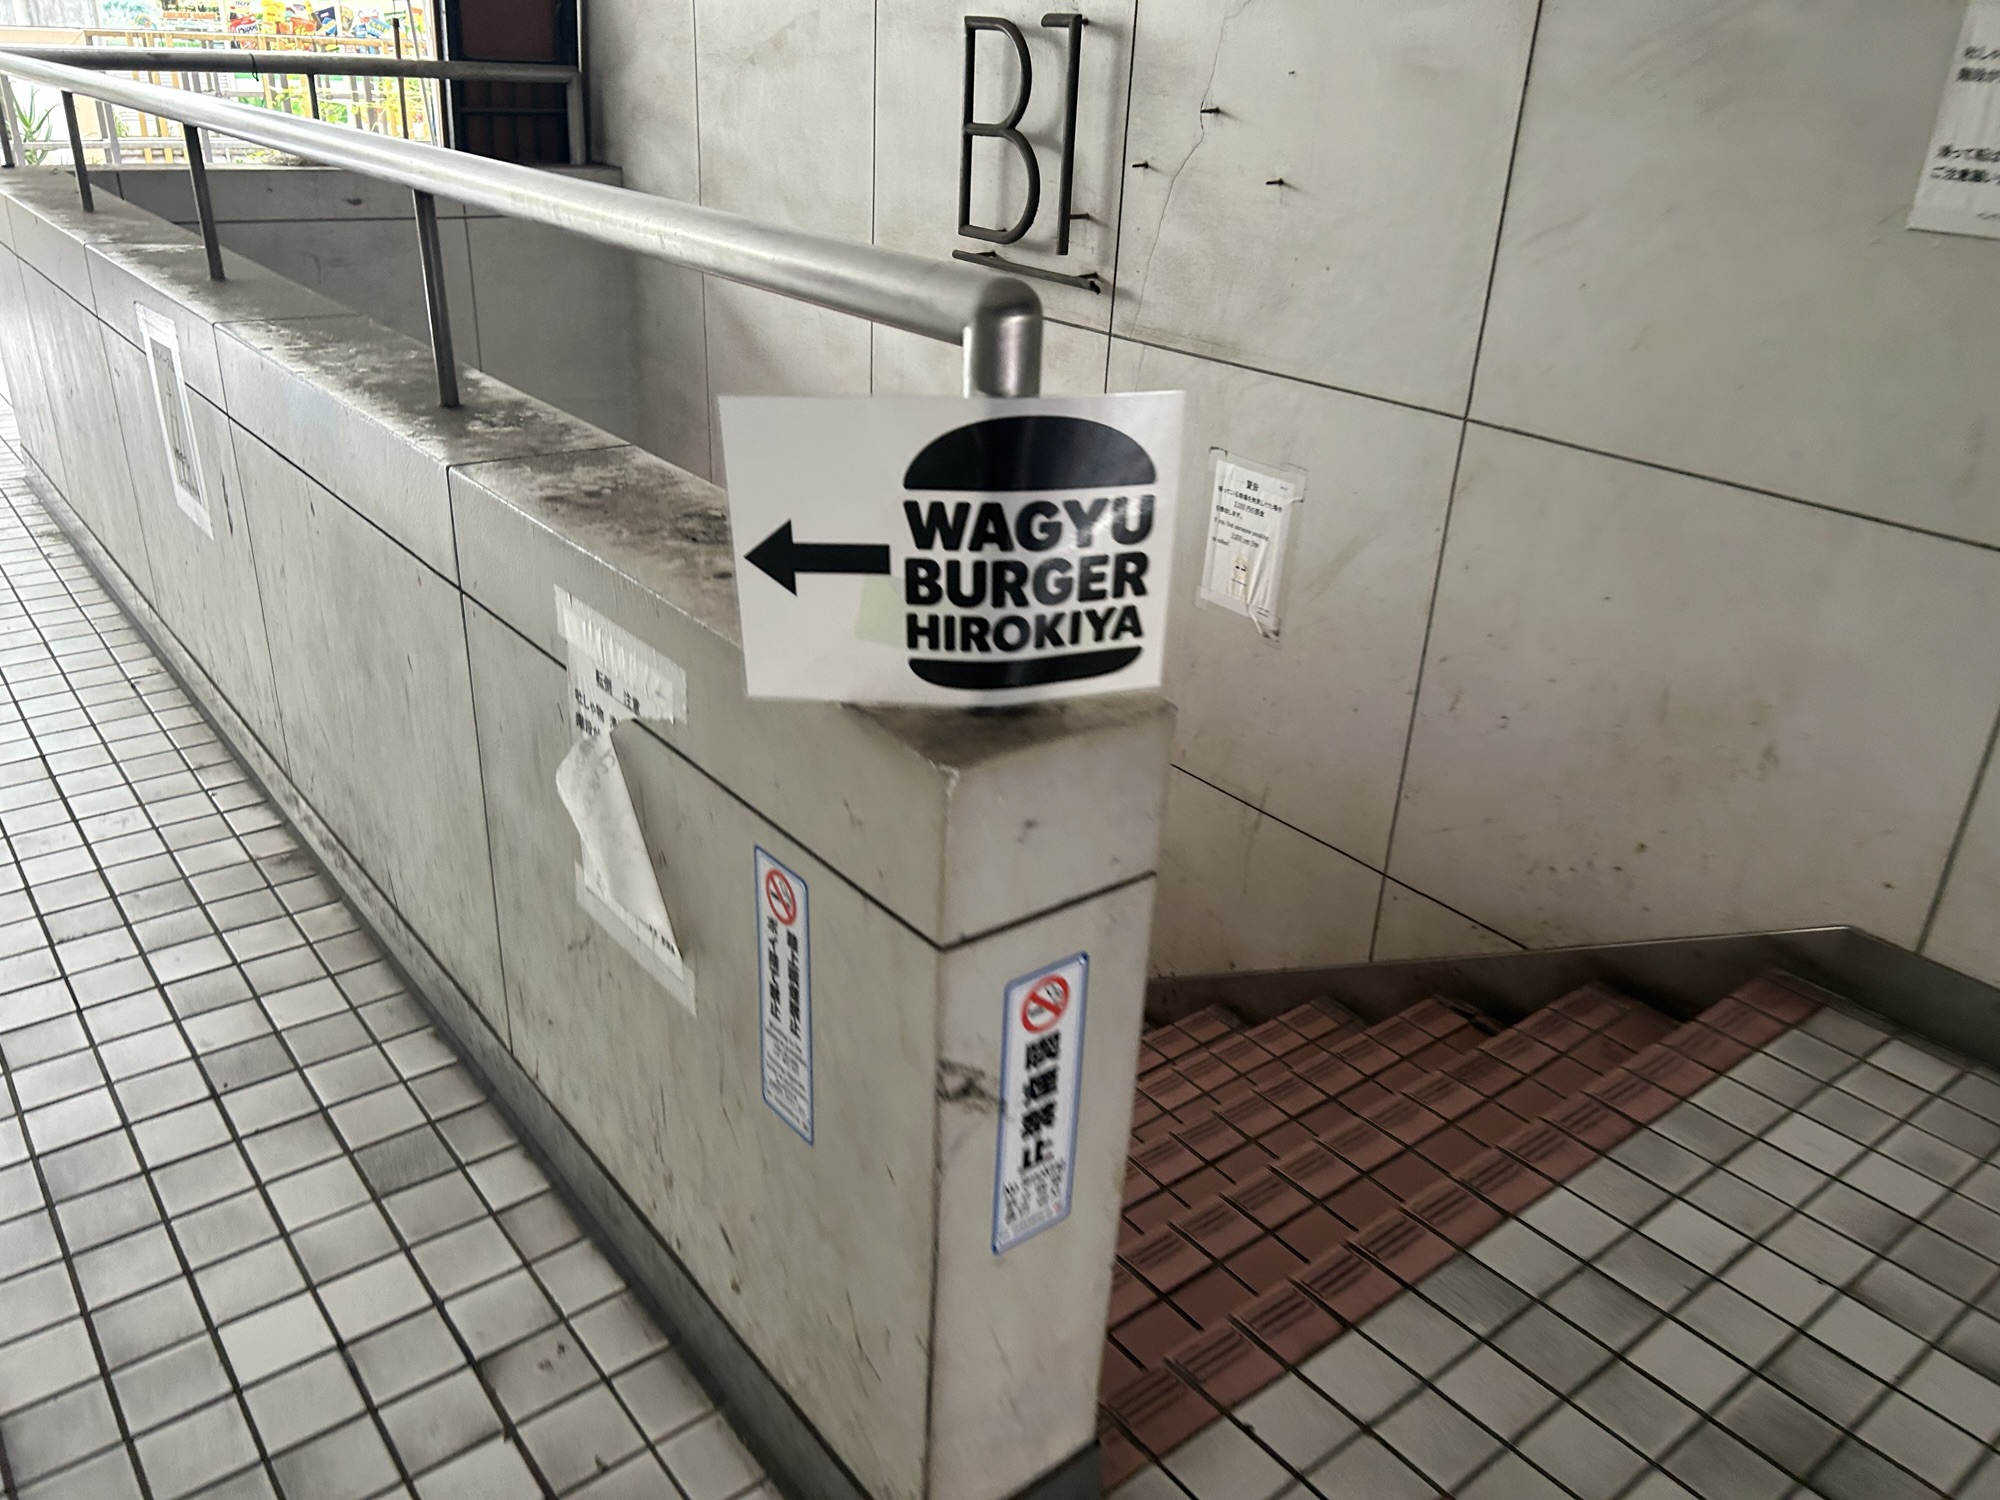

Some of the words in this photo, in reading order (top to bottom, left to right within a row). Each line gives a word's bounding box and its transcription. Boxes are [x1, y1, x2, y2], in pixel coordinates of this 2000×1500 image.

[904, 494, 1156, 552] WAGYU
[905, 551, 1148, 608] BURGER
[906, 605, 1144, 653] HIROKIYA
